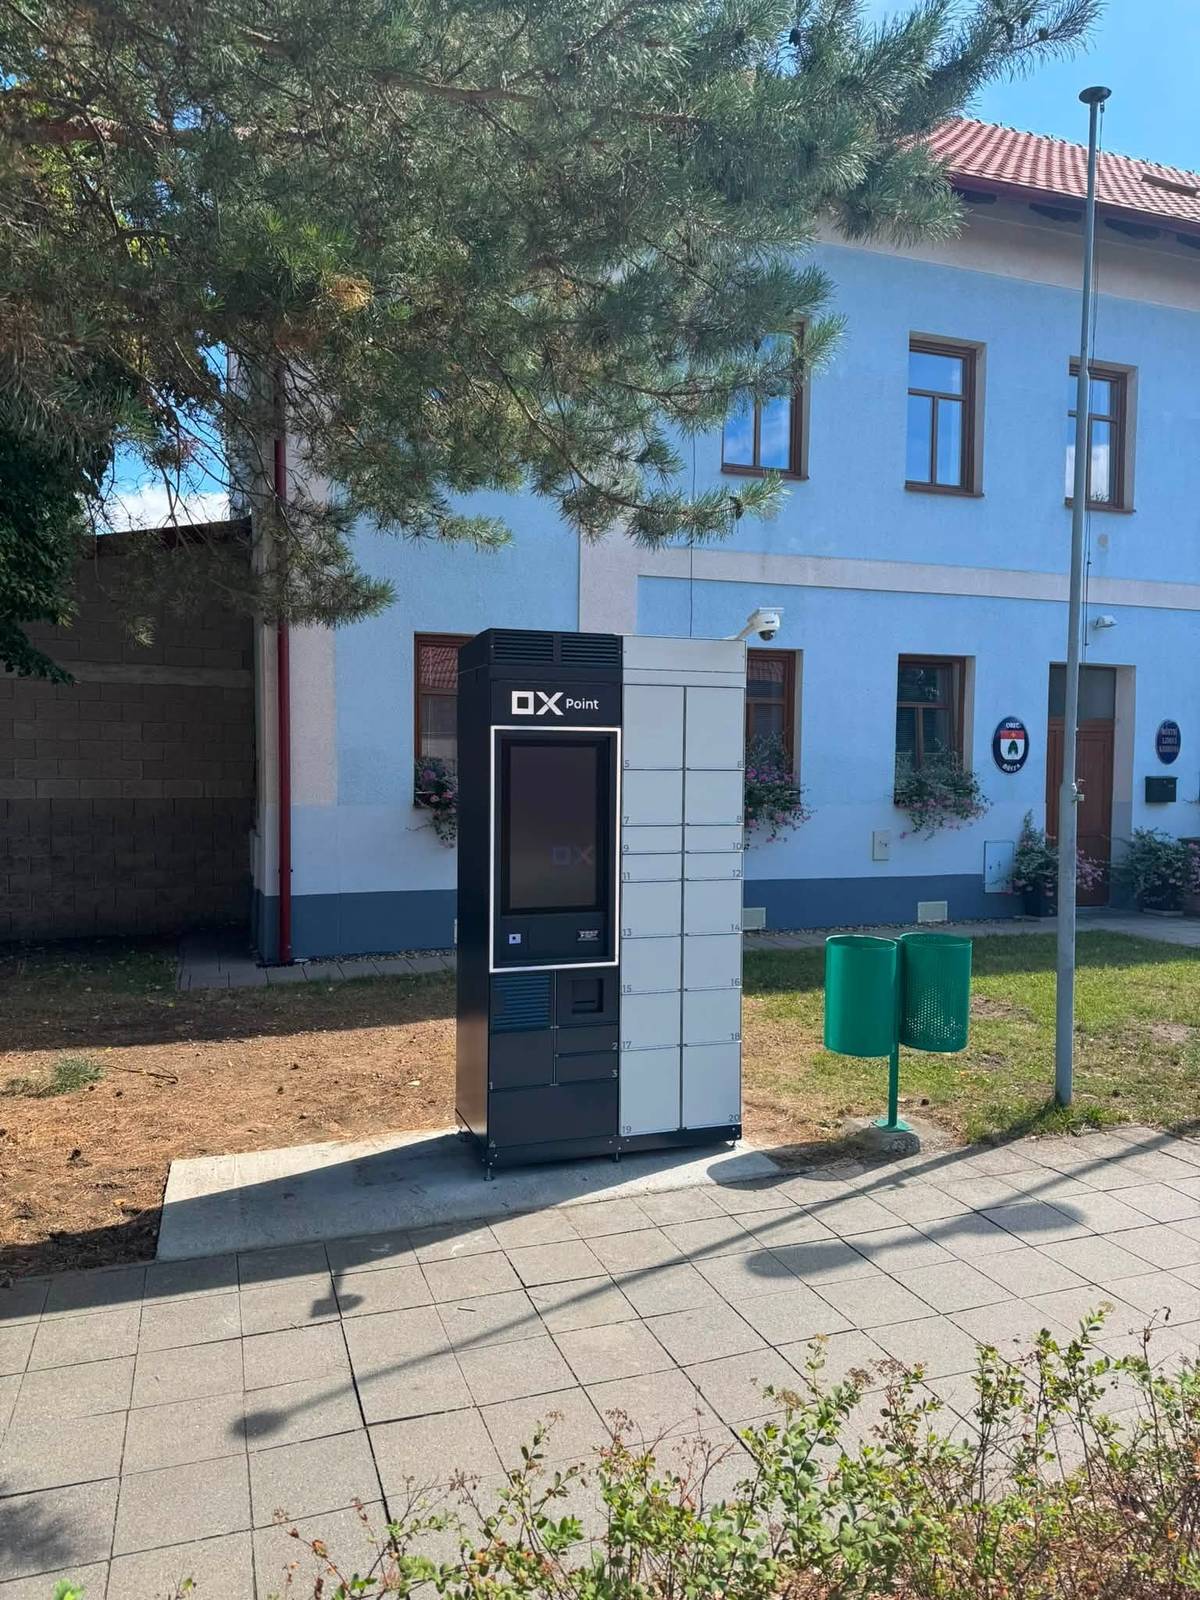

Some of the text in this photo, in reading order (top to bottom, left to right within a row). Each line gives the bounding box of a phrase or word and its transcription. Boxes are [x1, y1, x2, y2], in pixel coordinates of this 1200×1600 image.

[512, 691, 599, 715] OX Point
[623, 872, 630, 880] 11
[612, 1070, 617, 1078] 3
